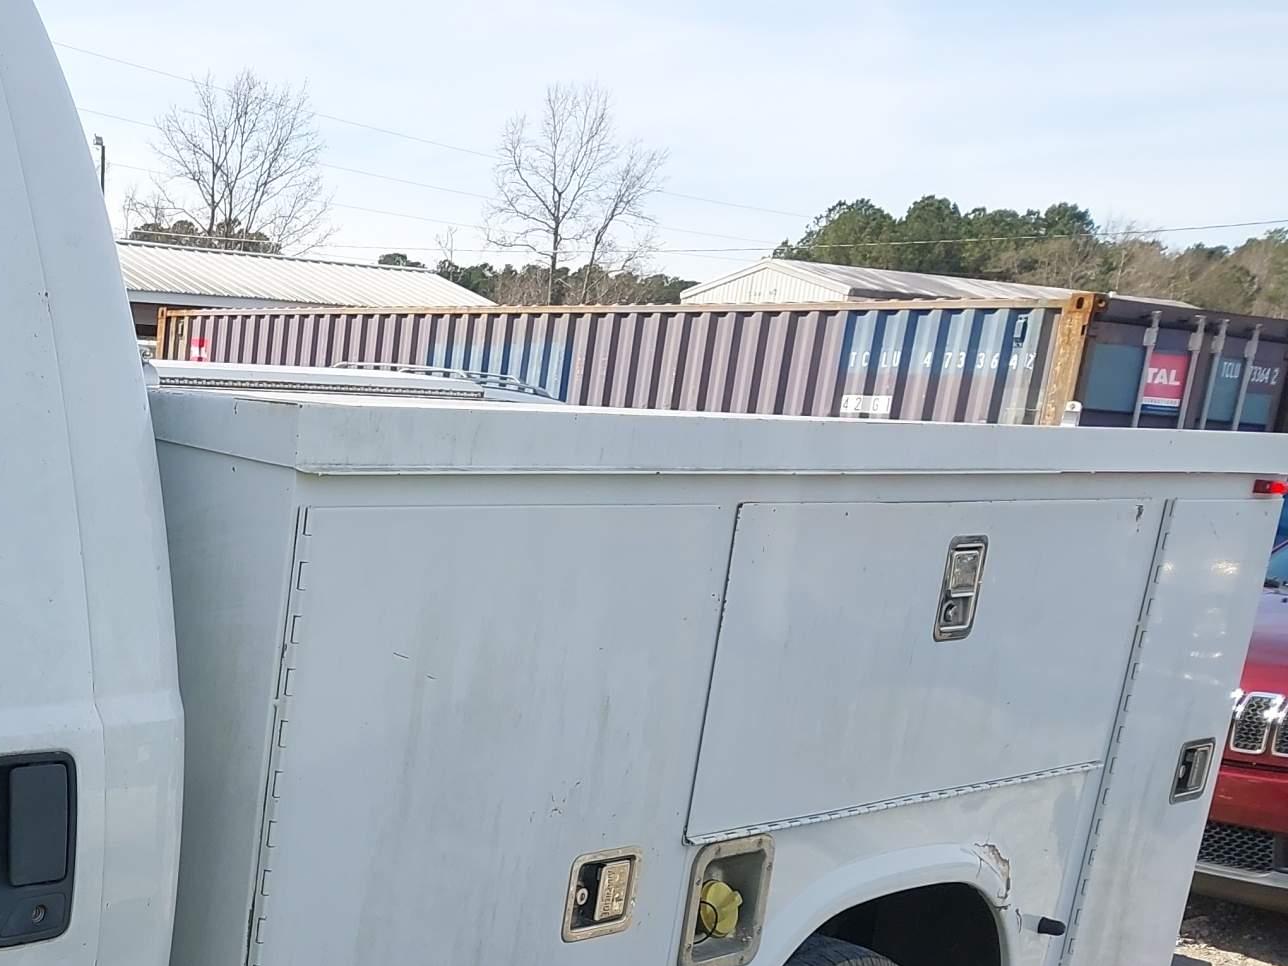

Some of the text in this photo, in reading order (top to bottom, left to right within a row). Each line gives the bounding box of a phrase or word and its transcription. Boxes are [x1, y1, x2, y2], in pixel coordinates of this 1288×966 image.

[849, 351, 902, 368] TCLU
[1146, 367, 1181, 386] TAL
[1221, 361, 1241, 378] TCLU
